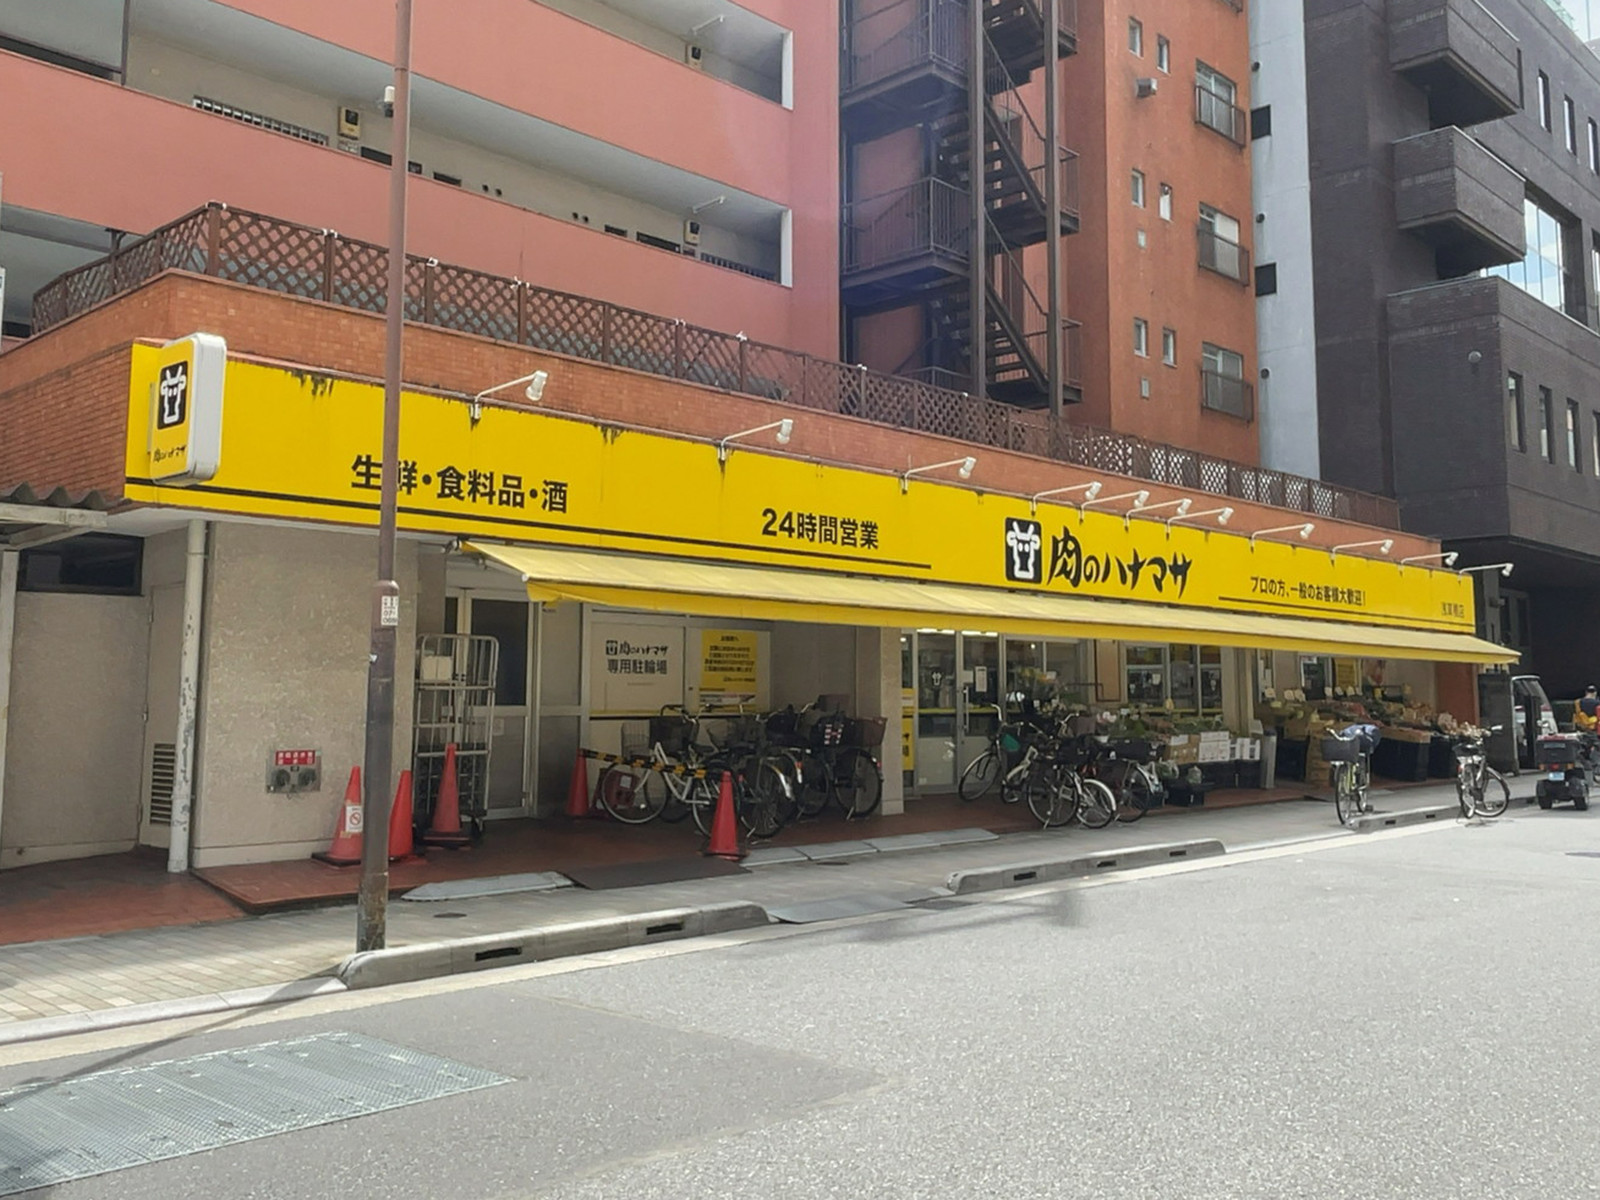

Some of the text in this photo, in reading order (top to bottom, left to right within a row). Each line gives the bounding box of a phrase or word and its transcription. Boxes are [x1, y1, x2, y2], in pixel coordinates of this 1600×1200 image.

[761, 507, 879, 550] 24時間営業
[1047, 525, 1193, 599] 肉のハナマサ
[607, 658, 667, 675] 専用駐輪場
